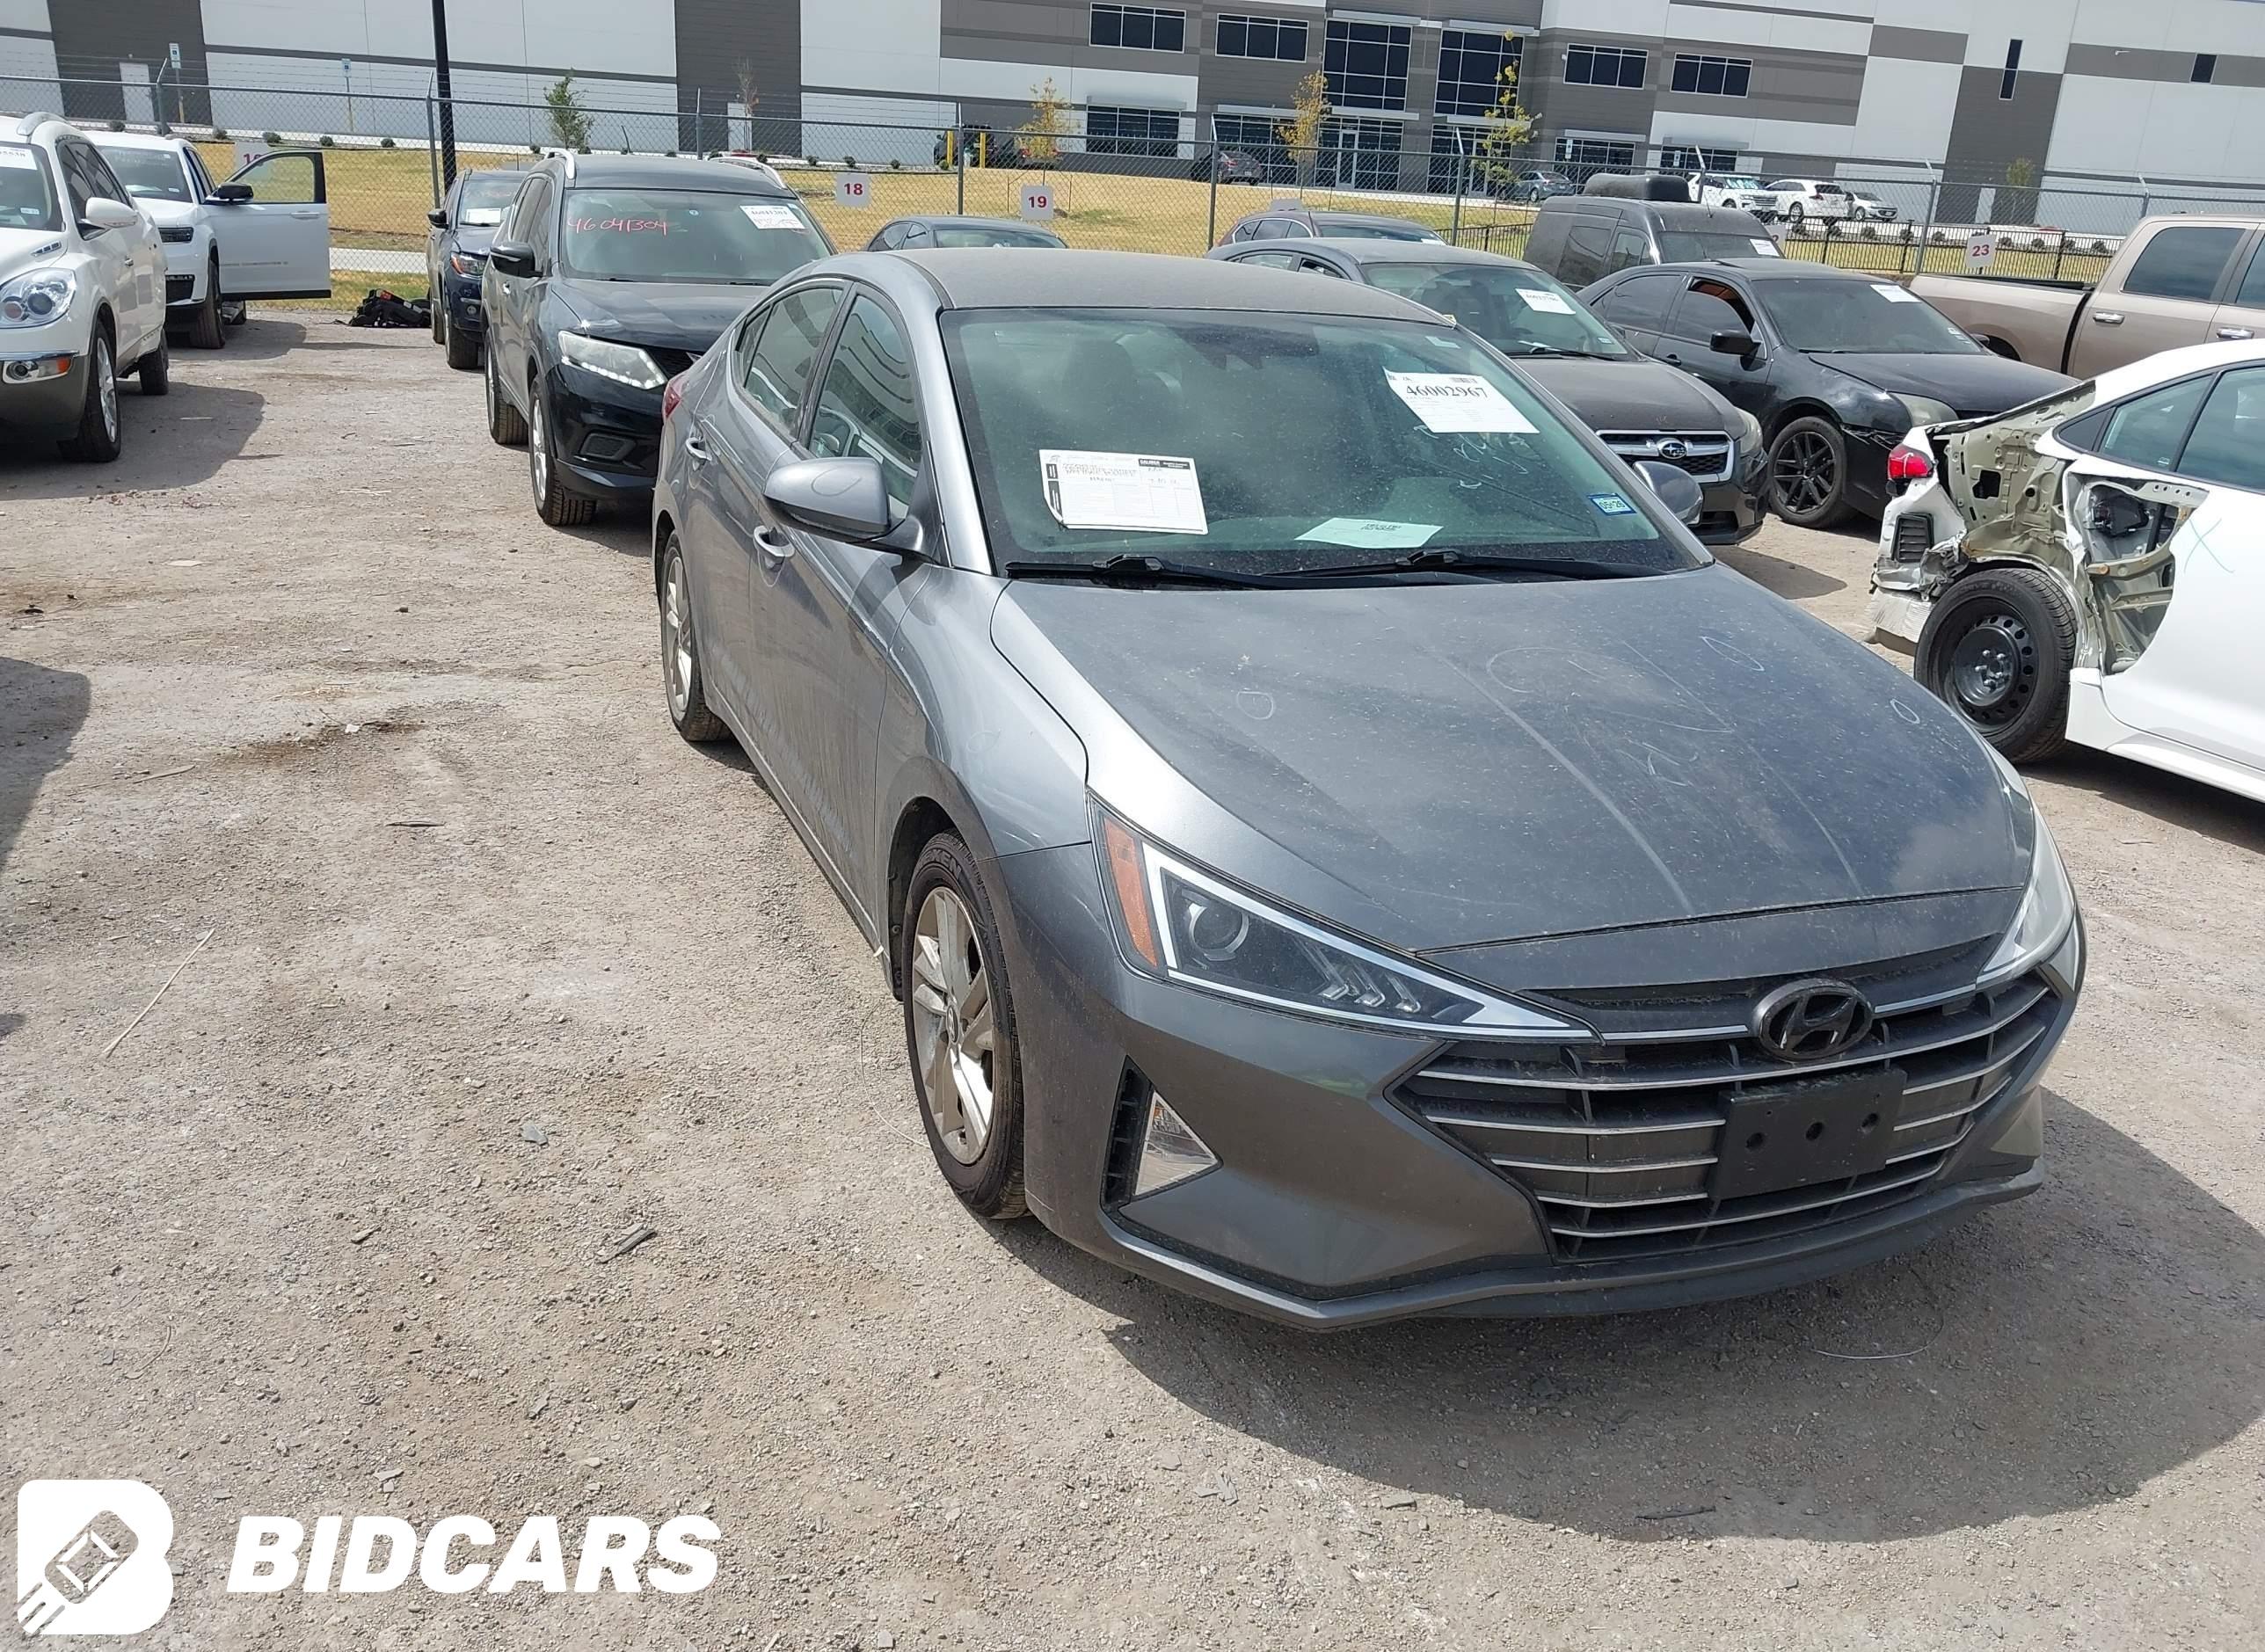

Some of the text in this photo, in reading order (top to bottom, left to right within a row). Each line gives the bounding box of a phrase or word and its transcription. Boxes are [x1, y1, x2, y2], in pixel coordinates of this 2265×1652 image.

[844, 183, 863, 195] 18
[1028, 195, 1047, 208] 19
[1972, 244, 1990, 257] 23
[1406, 385, 1489, 398] 46002967
